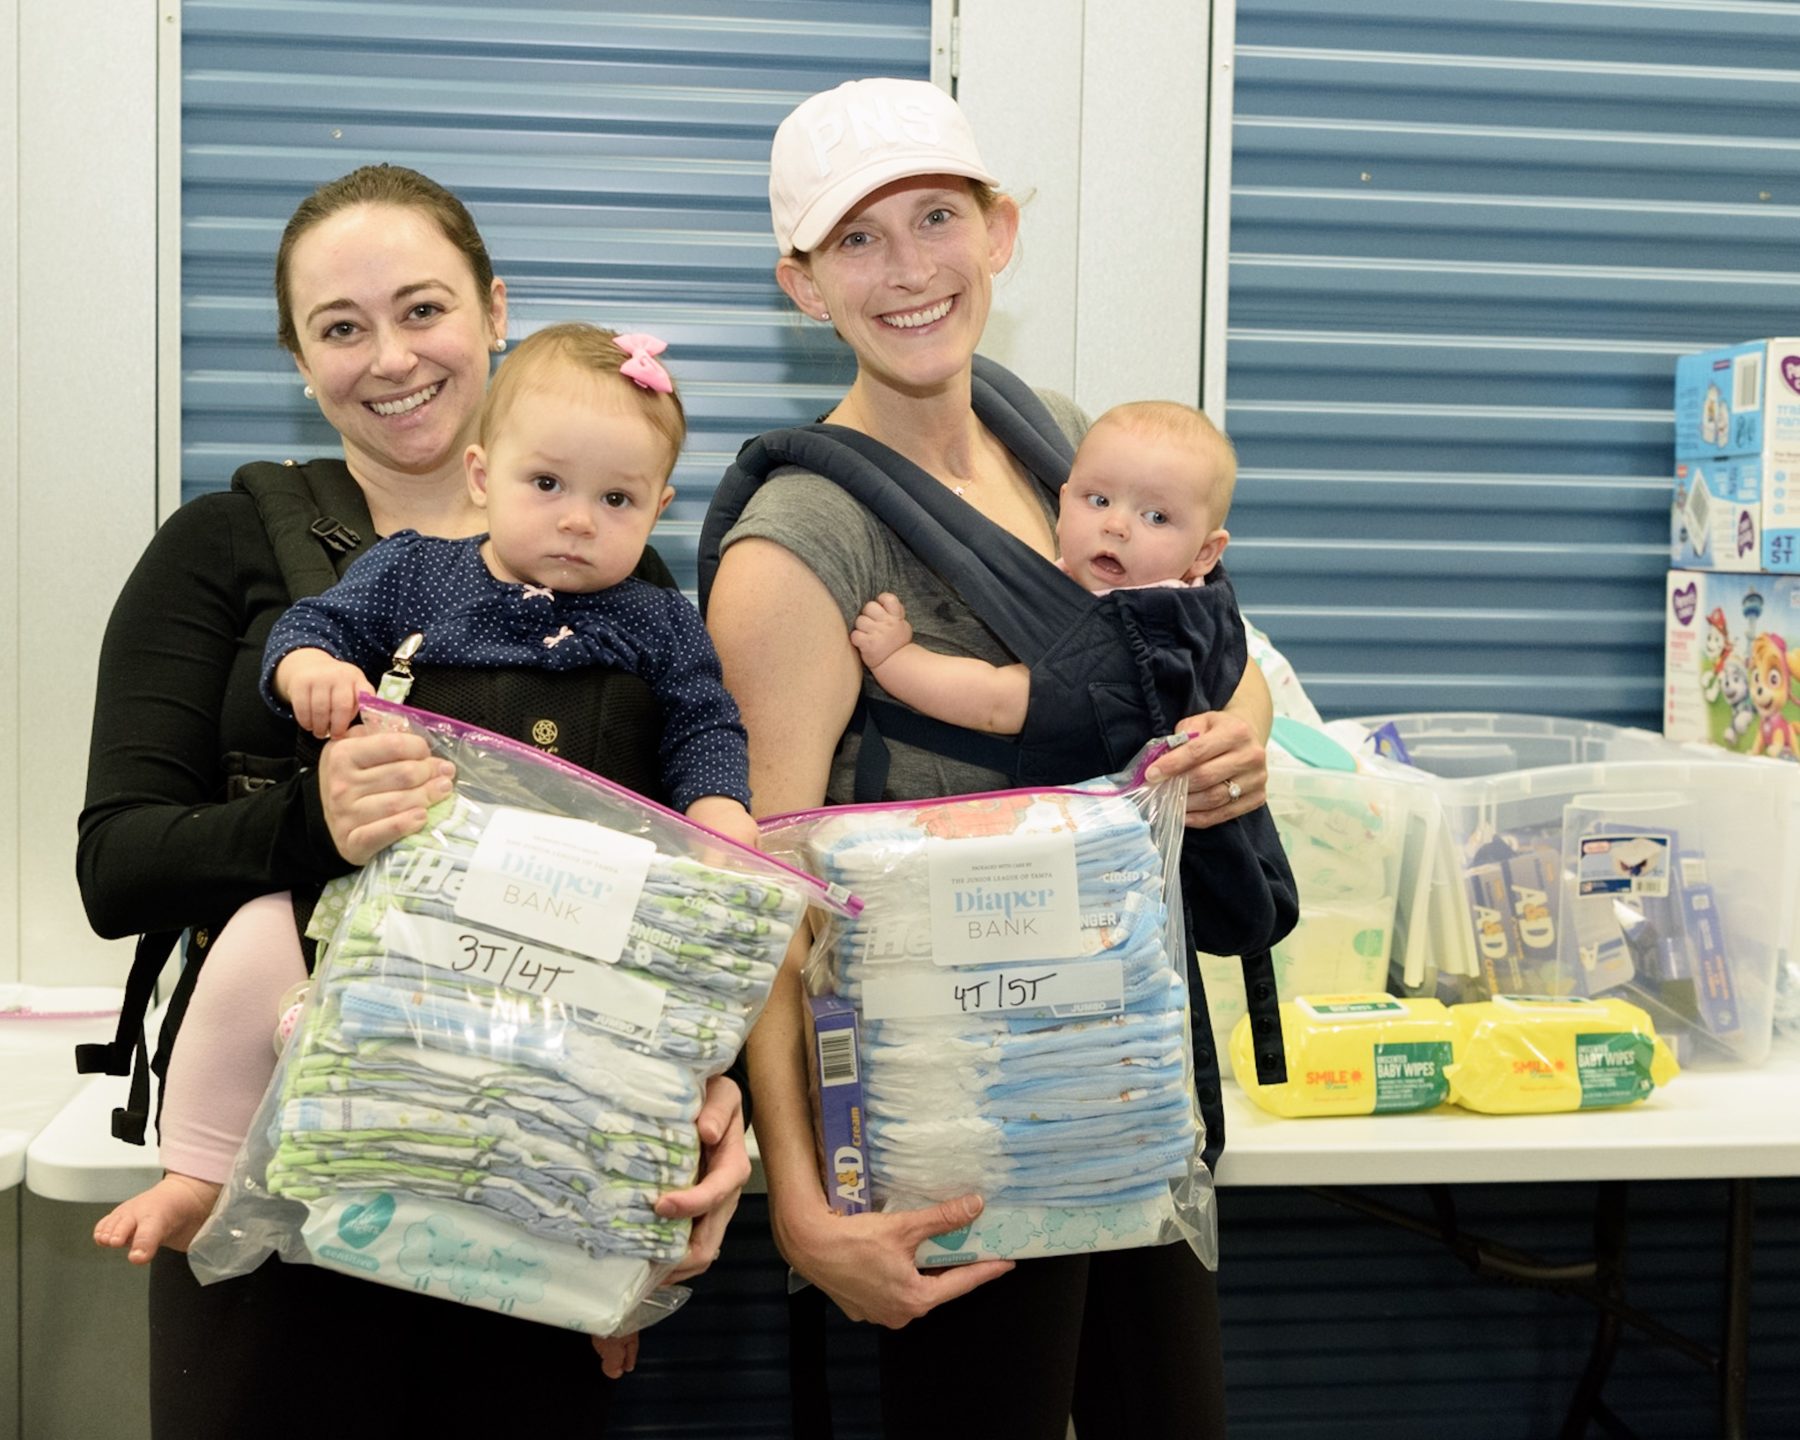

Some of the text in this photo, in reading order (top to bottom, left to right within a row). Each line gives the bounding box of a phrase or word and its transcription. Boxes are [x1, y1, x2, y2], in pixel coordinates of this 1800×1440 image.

[807, 98, 941, 177] PNS
[501, 851, 614, 899] Diaper
[1019, 873, 1029, 881] OF
[1030, 872, 1053, 880] TAMPA
[1103, 871, 1140, 883] CLOSED
[503, 884, 583, 925] BANK
[955, 886, 1055, 921] Diaper
[968, 917, 1039, 939] BANK
[1079, 911, 1118, 928] NGER
[628, 921, 682, 953] ONGER
[451, 934, 575, 993] 3T/4T
[1071, 1001, 1107, 1014] JUMBO
[592, 1013, 637, 1034] JUMBO
[1512, 1060, 1553, 1074] SMILE
[1578, 1050, 1636, 1068] BABY WIPES
[1306, 1070, 1348, 1085] SMILE
[1377, 1061, 1436, 1079] BABY WIPES
[833, 1106, 868, 1206] A&D cream
